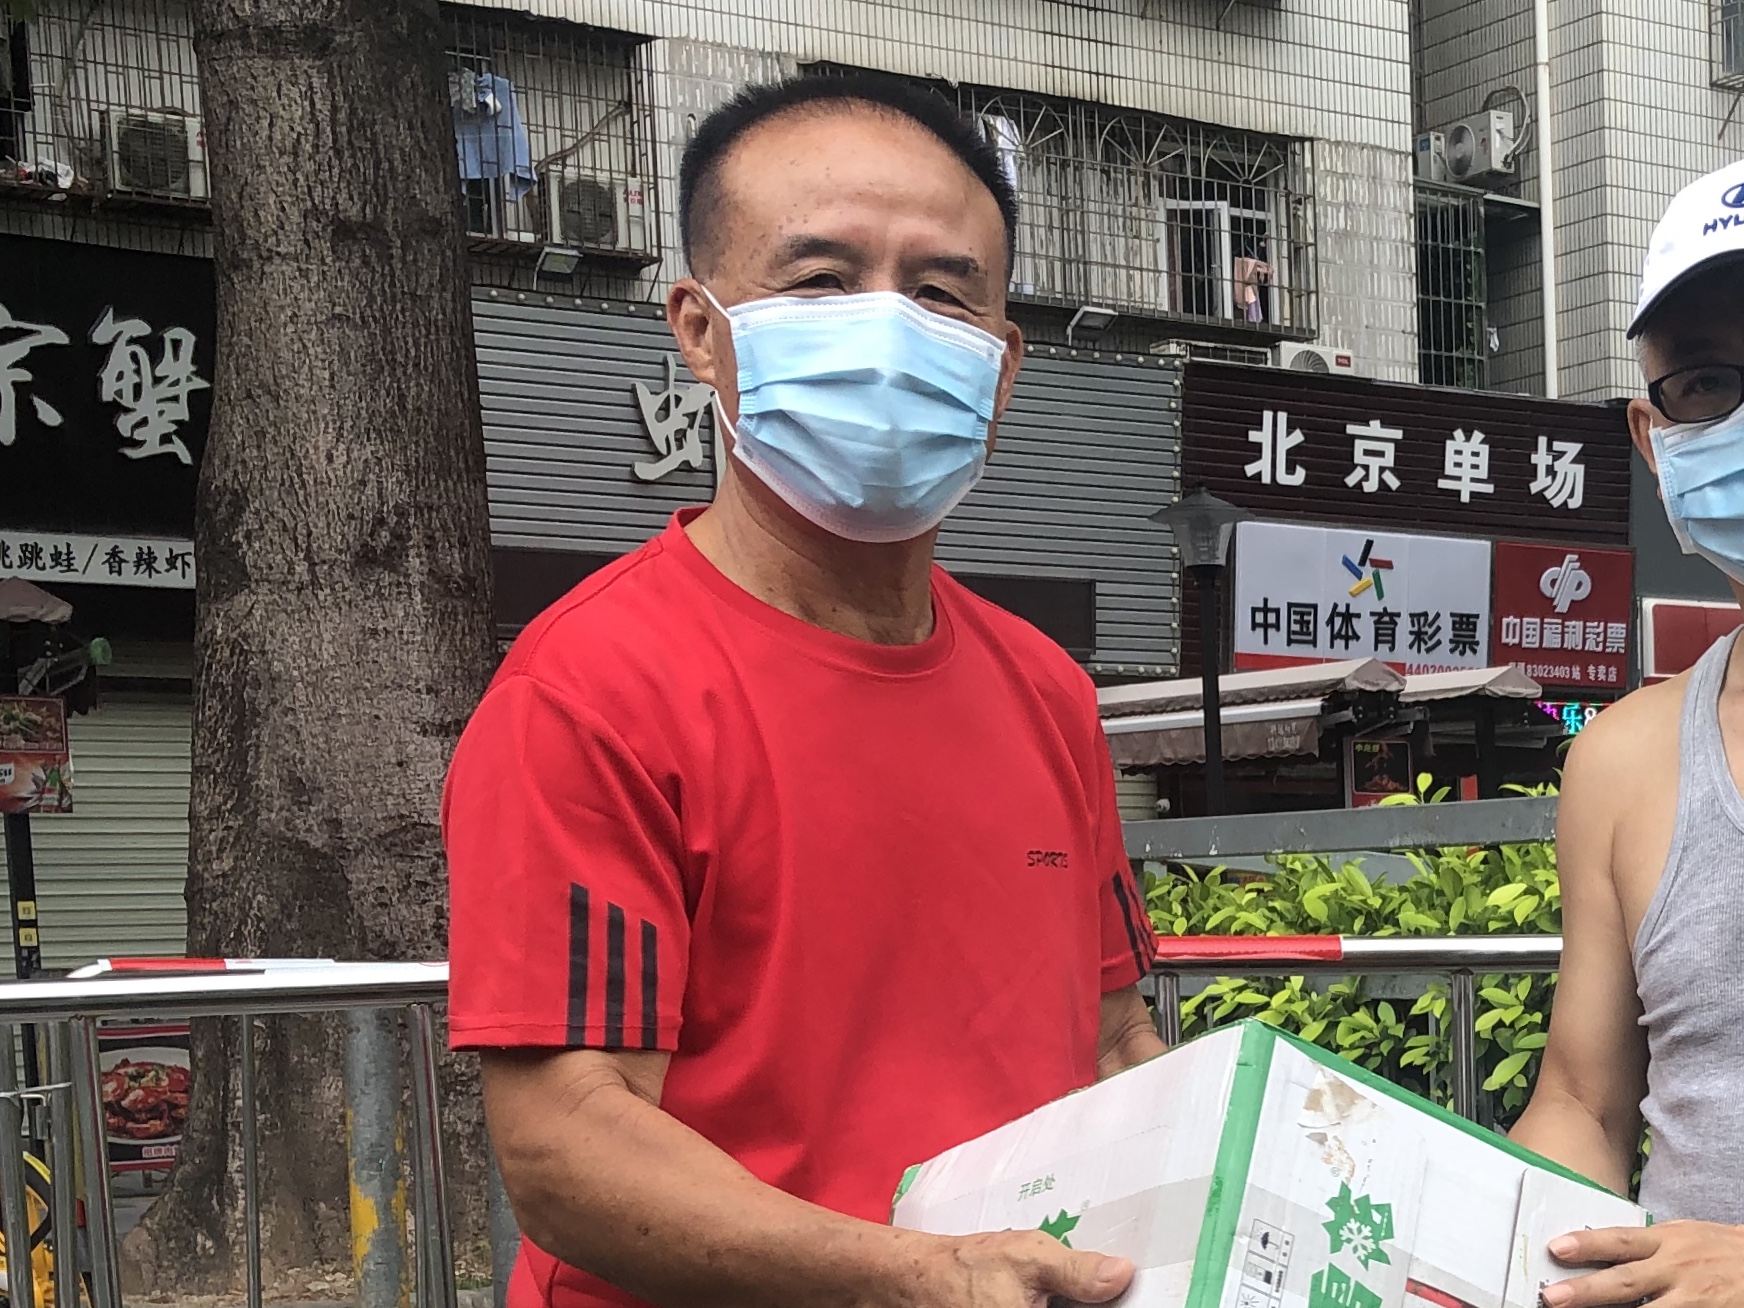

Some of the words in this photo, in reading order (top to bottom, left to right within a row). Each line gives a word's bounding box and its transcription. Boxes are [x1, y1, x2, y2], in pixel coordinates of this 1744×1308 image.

[1243, 410, 1587, 510] 北京单场
[1250, 597, 1481, 657] 中国体育彩票
[1501, 615, 1627, 654] 中国福利彩票
[1587, 664, 1617, 682] 专卖店
[1017, 1172, 1056, 1202] 开启处
